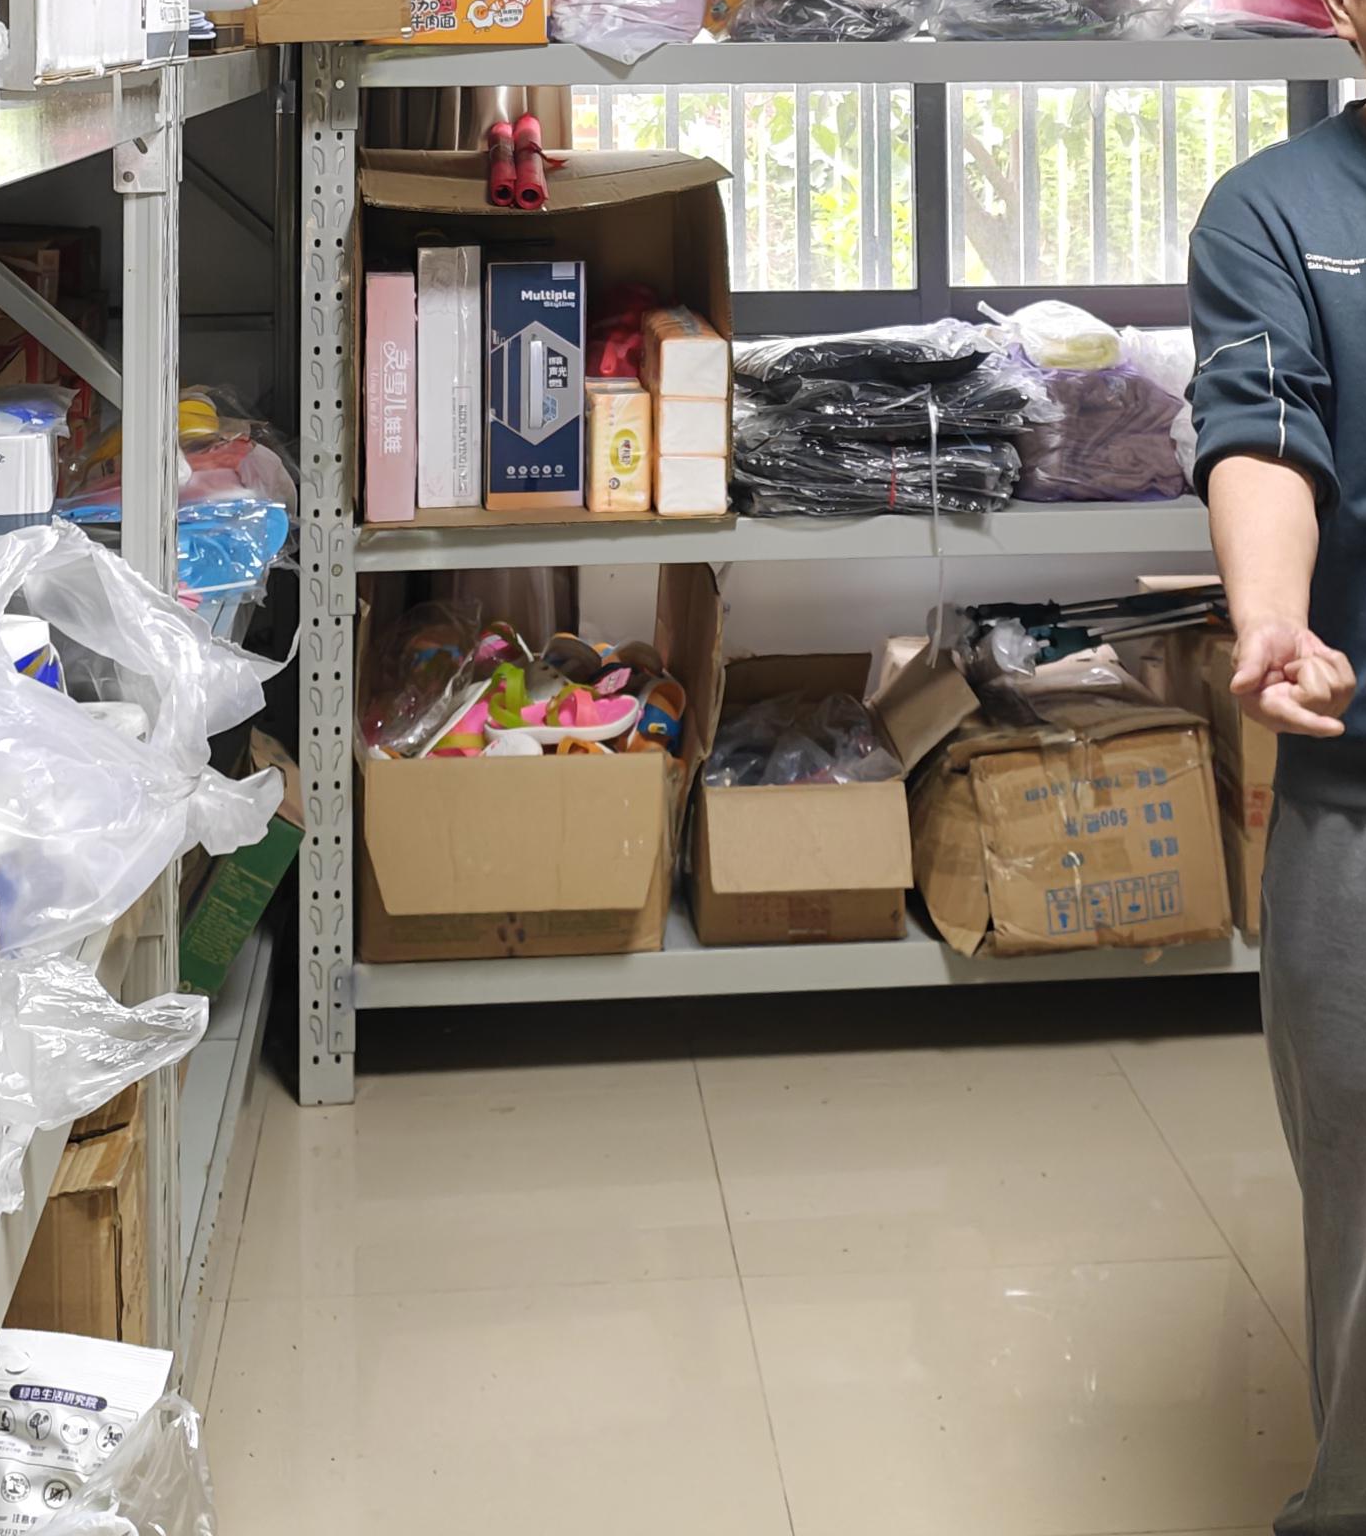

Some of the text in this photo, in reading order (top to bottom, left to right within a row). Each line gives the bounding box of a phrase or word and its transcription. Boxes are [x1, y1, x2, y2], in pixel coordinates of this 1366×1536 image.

[521, 290, 575, 301] Multiple
[18, 1386, 99, 1410] 绿色生活研究院
